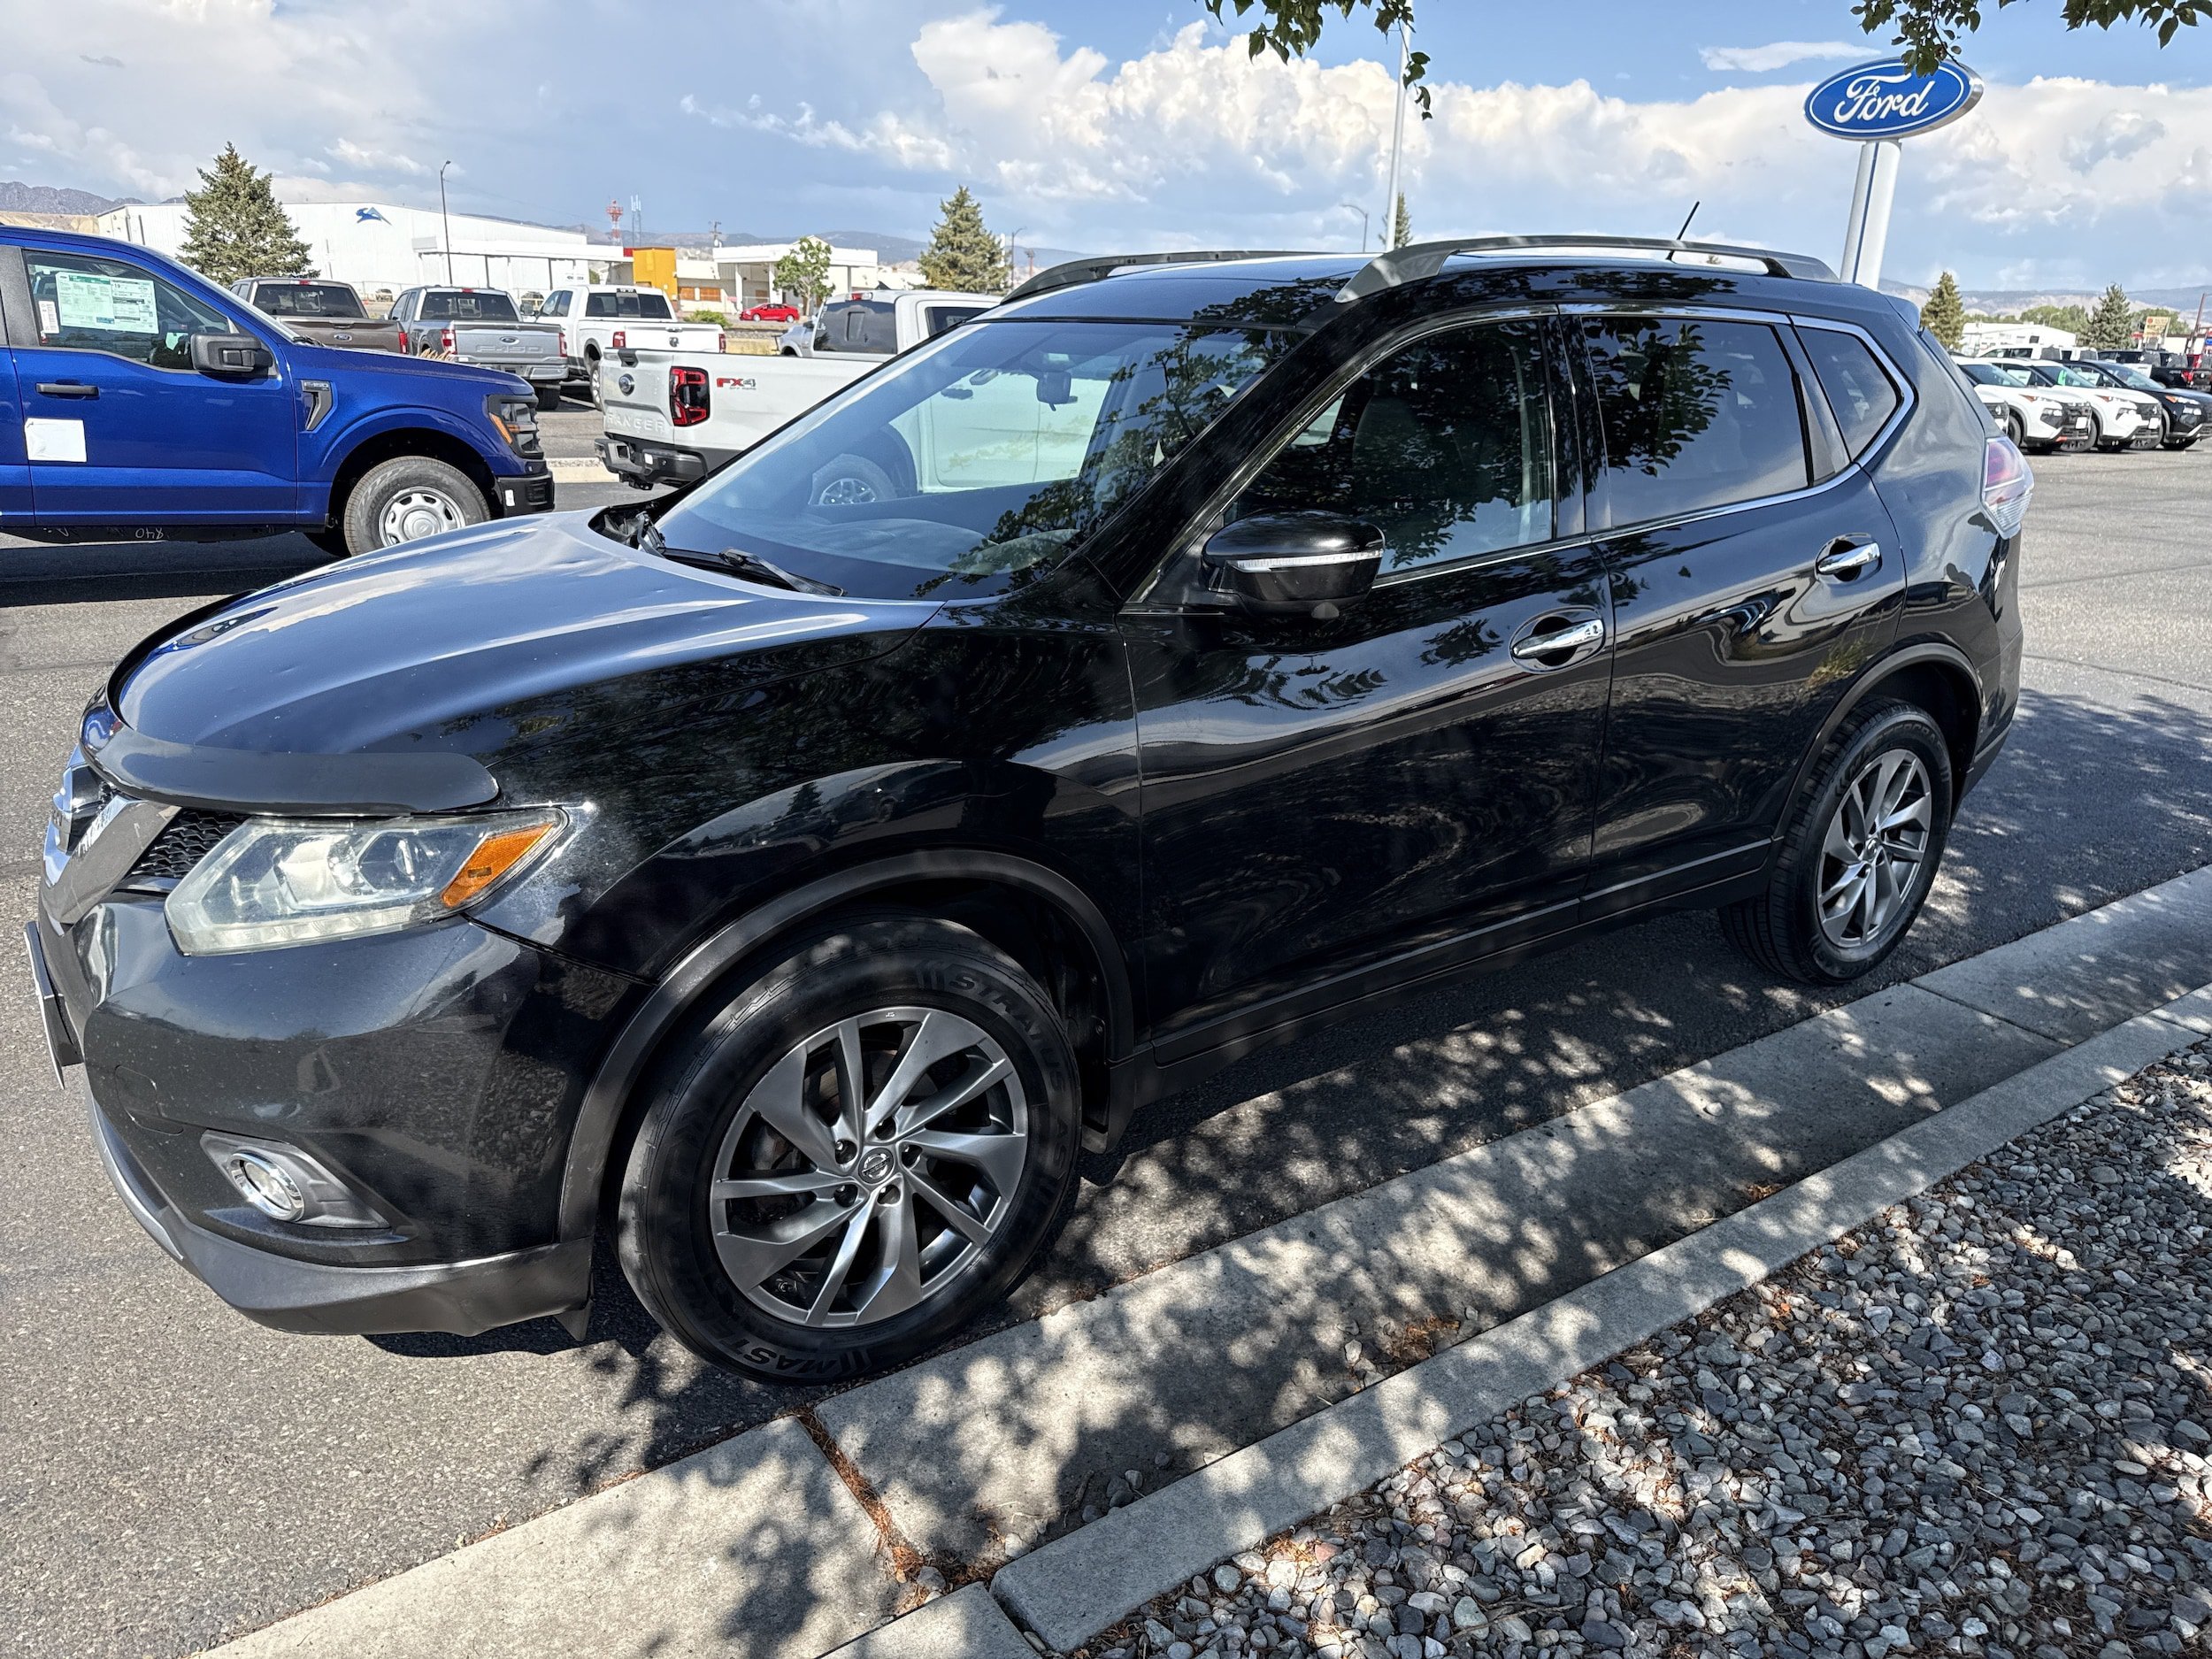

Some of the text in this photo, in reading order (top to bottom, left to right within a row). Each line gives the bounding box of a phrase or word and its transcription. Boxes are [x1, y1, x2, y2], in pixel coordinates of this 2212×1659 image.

[1833, 73, 1936, 124] Ford
[477, 345, 543, 354] F-150
[716, 378, 757, 388] FX4
[606, 411, 664, 433] RANGER
